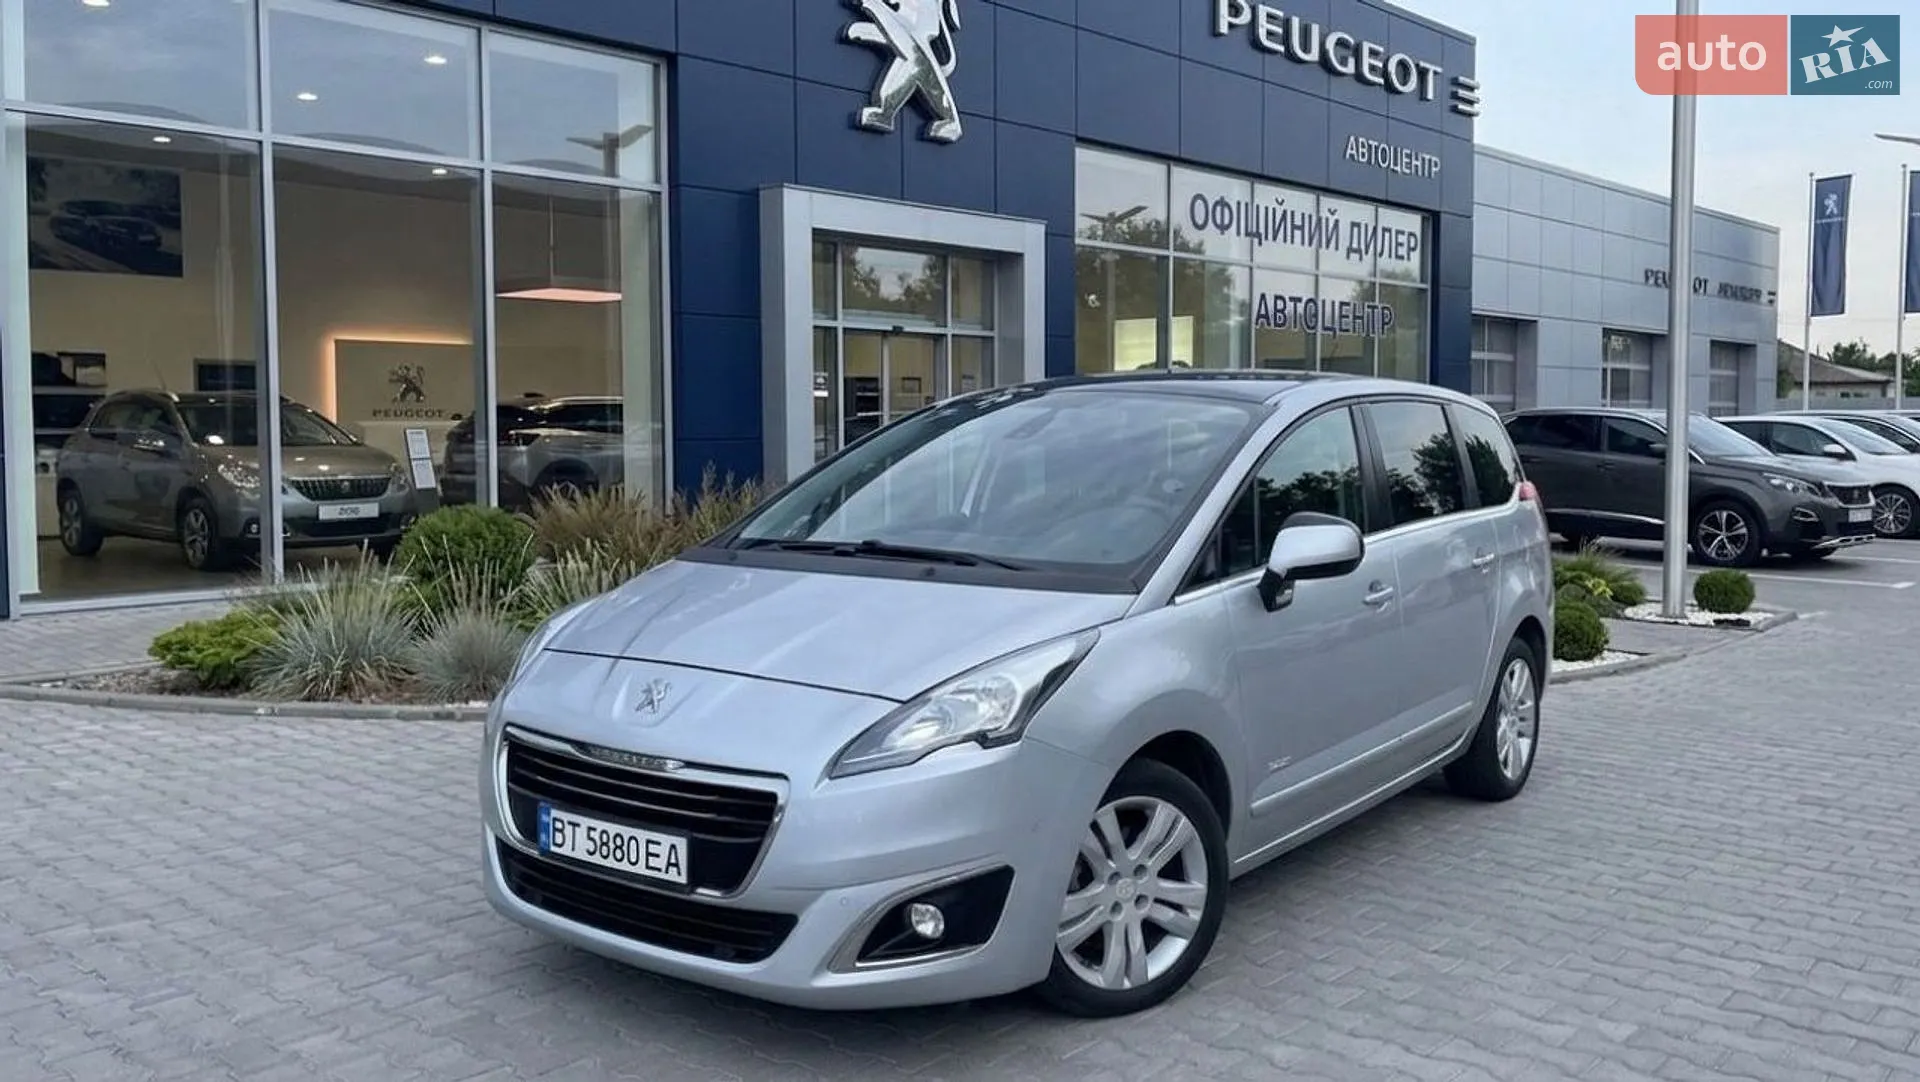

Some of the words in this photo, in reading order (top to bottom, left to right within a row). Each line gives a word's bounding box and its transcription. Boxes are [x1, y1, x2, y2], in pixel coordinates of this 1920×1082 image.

[1214, 0, 1443, 100] PEUGEOT
[1345, 135, 1441, 178] АВТОЦЕНТР
[1190, 193, 1340, 251] ОФІЦІЙНИЙ
[1346, 221, 1418, 262] ДИЛЕР
[1255, 292, 1394, 339] АВТОЦЕНТР
[585, 826, 640, 867] 5880
